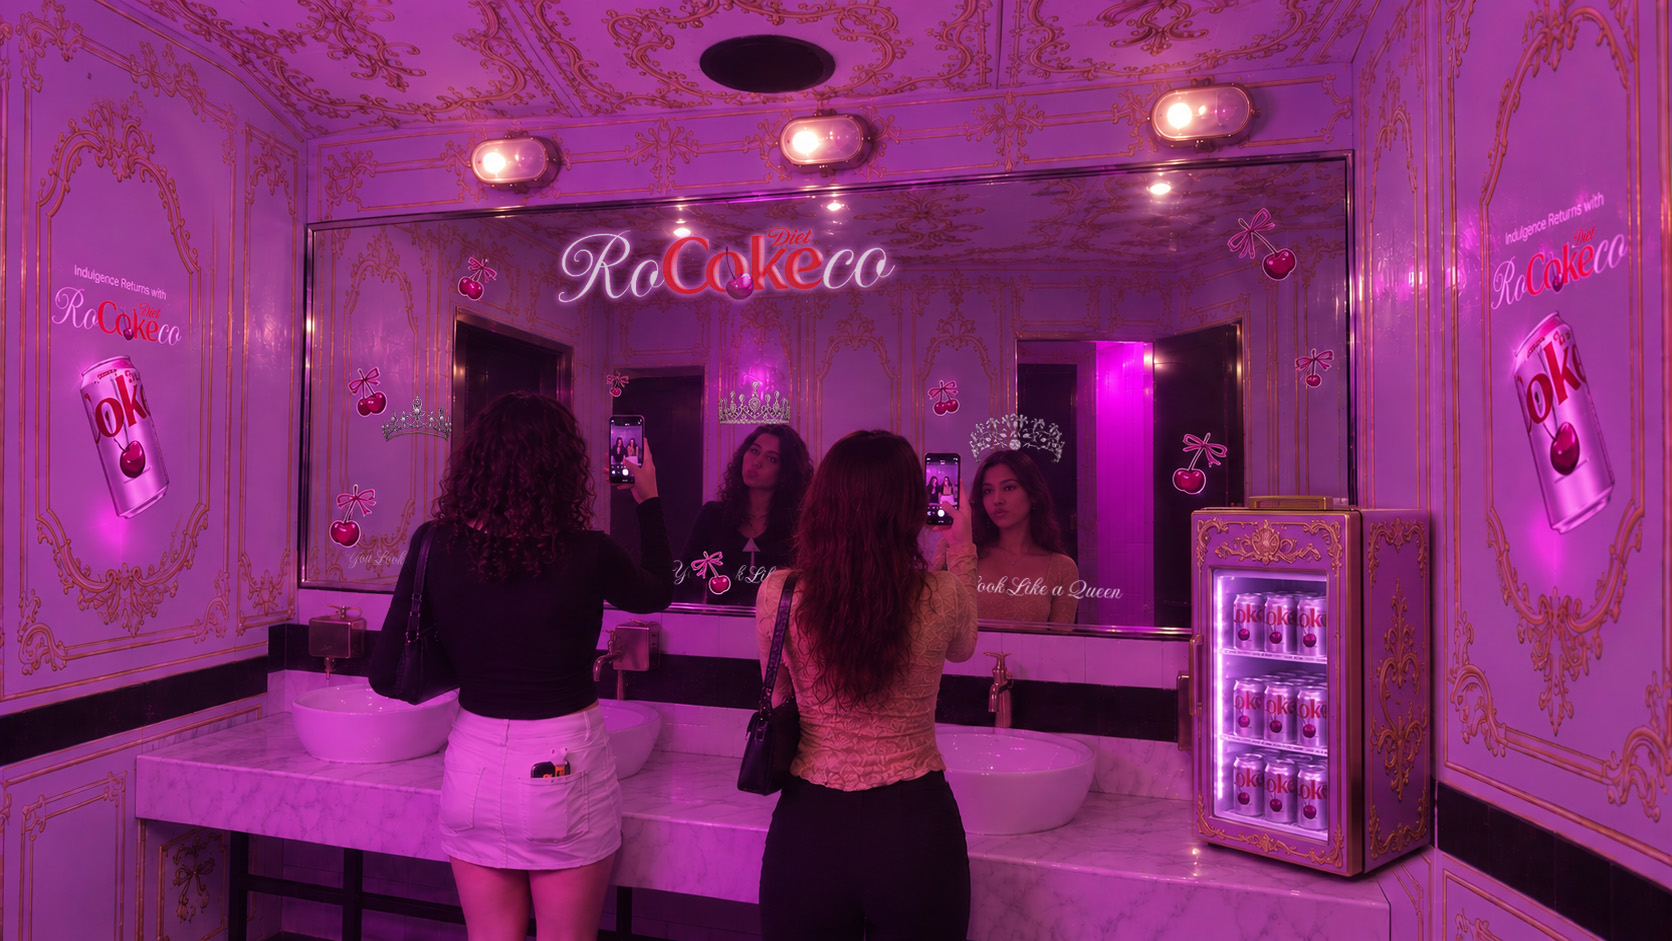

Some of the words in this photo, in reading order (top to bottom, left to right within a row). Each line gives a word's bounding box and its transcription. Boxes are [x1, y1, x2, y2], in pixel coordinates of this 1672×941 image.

[1505, 219, 1547, 245] Indulgence
[1548, 204, 1582, 226] Returns
[1583, 192, 1604, 212] with
[767, 227, 814, 247] Diet
[1573, 225, 1595, 247] Diet
[74, 264, 120, 287] Indulgence
[120, 278, 150, 296] Returns
[151, 287, 167, 300] with
[139, 302, 161, 319] Diet
[349, 550, 372, 568] You
[977, 575, 1008, 593] ook
[1006, 576, 1048, 596] Like
[1052, 585, 1064, 596] a
[1067, 579, 1123, 599] Queen
